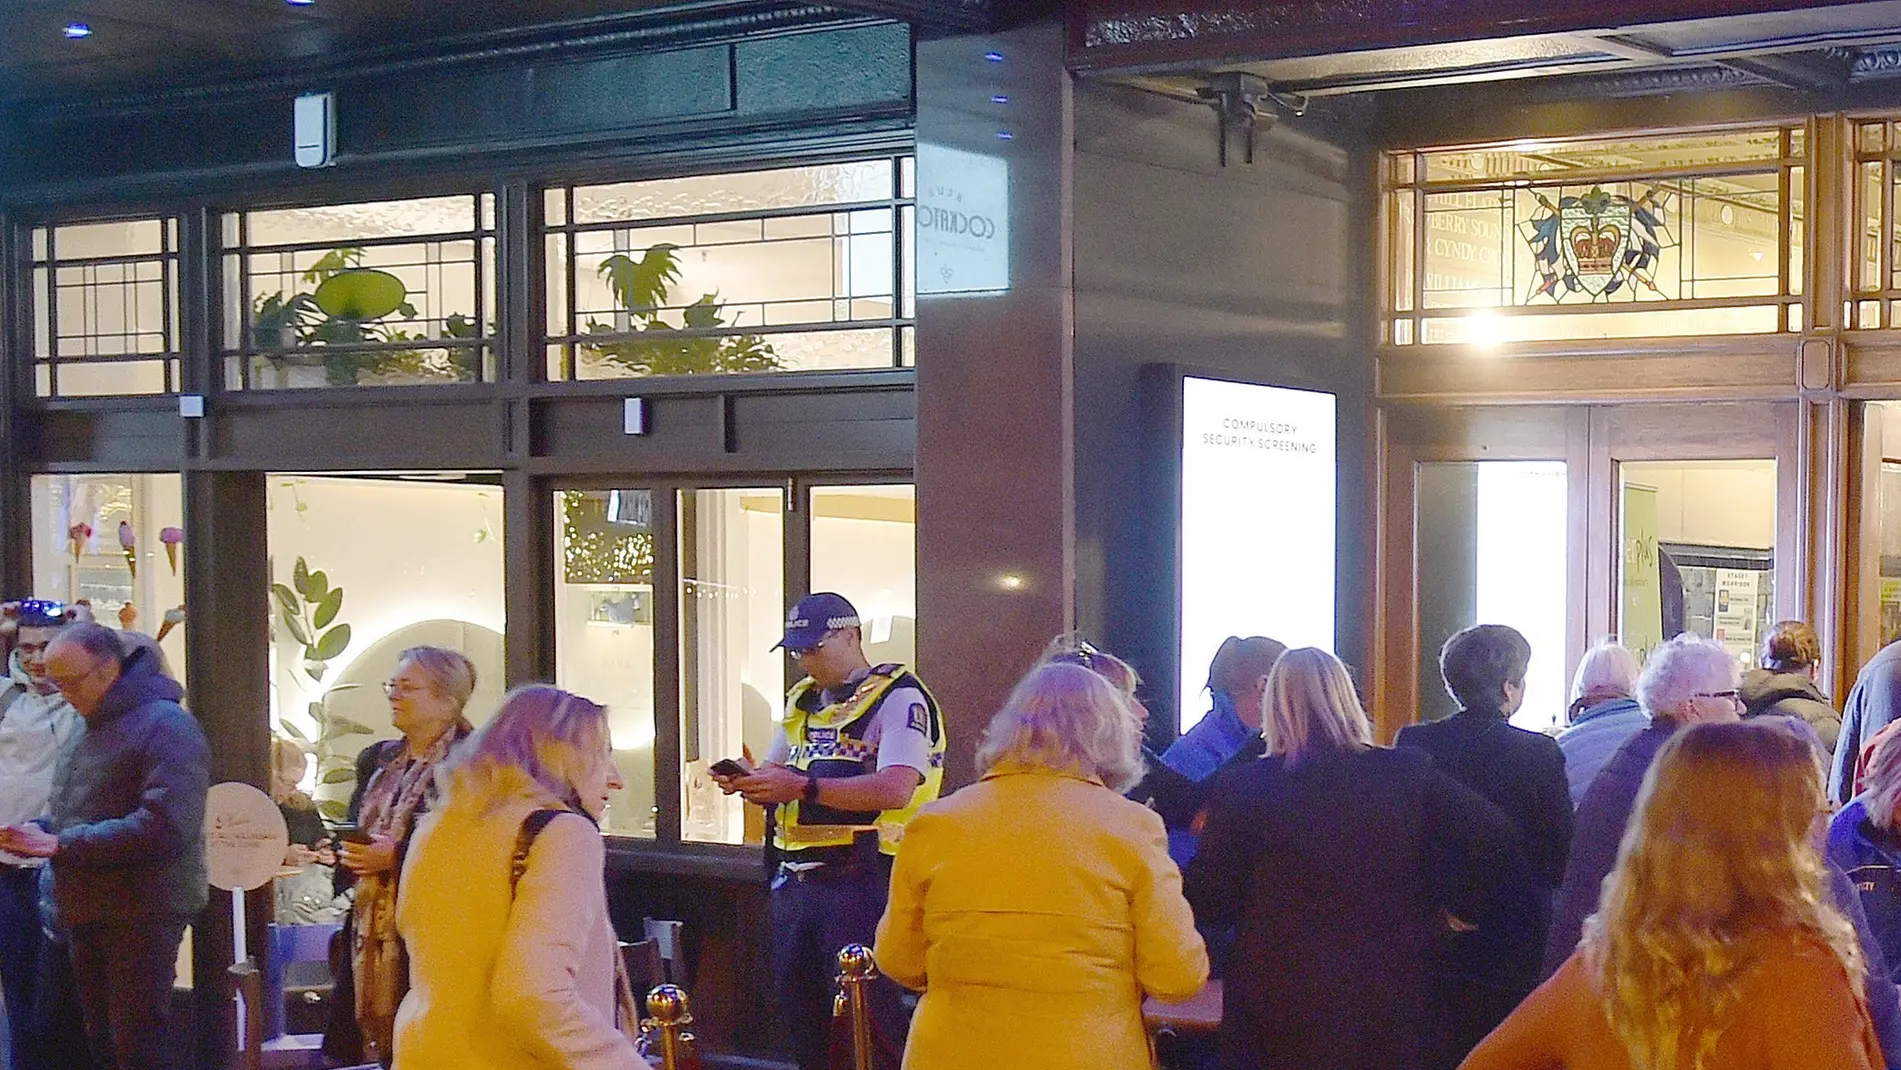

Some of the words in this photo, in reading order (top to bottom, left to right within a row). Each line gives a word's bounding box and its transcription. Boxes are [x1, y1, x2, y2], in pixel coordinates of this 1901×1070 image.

[1223, 418, 1298, 435] COMPULSORY
[1203, 433, 1255, 448] SECURITY
[1258, 438, 1317, 454] SCREENING
